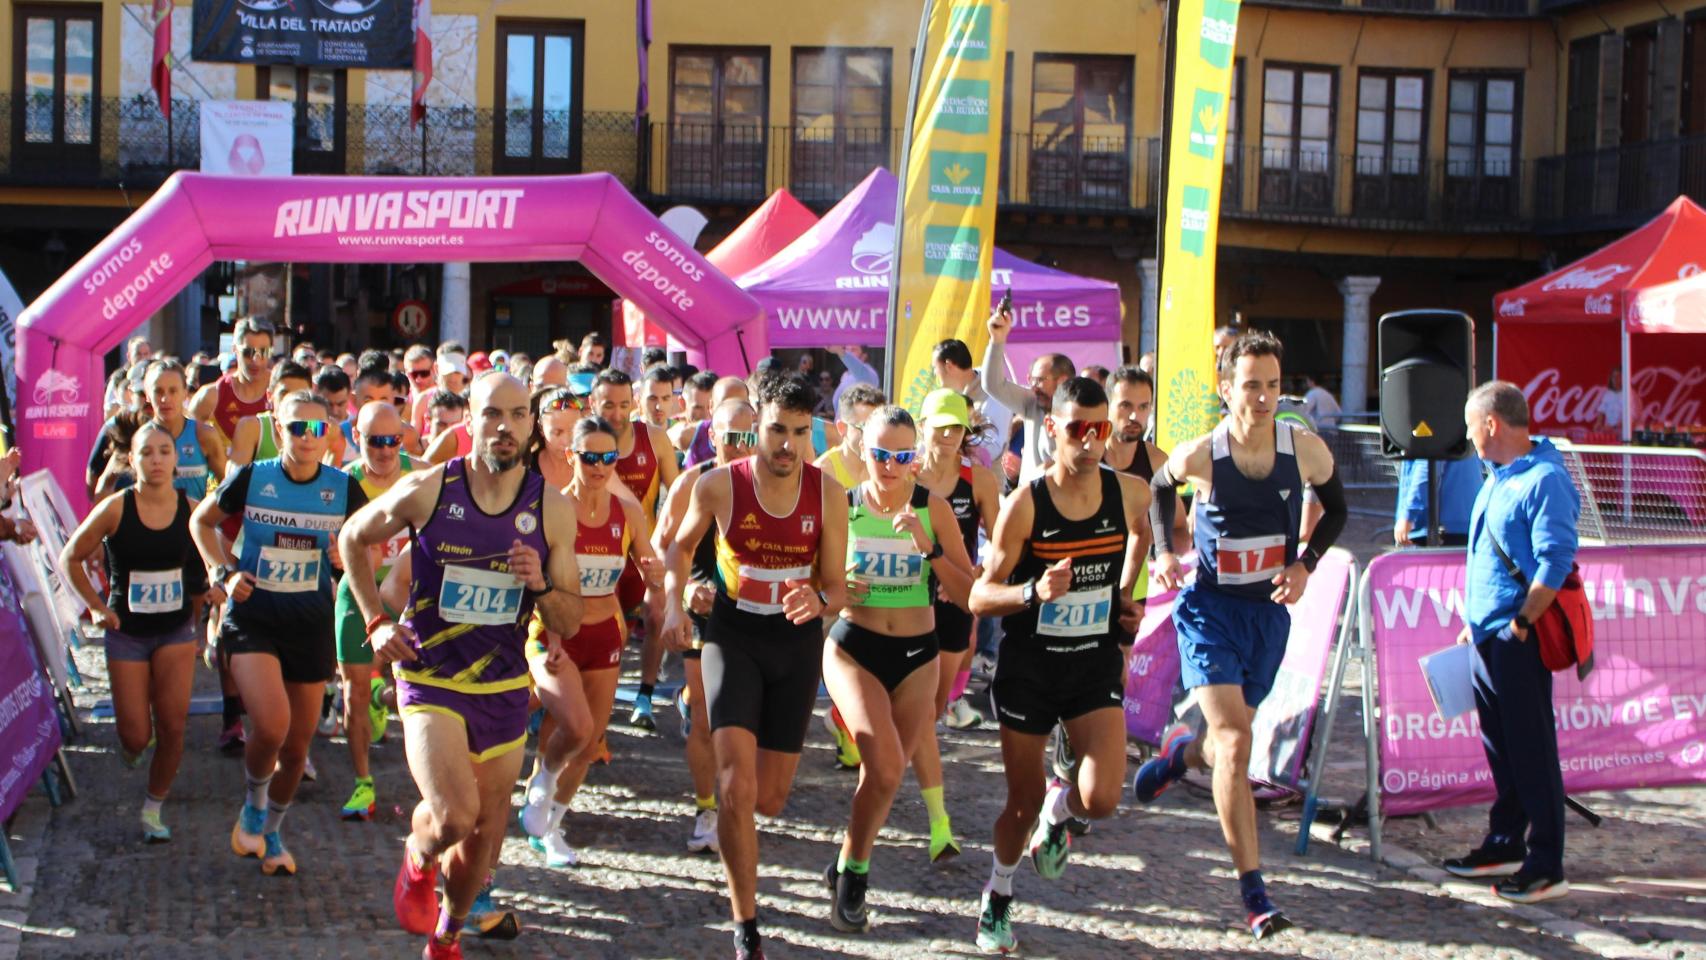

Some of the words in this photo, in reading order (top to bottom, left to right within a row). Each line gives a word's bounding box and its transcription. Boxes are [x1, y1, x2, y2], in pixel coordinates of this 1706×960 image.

[280, 18, 306, 32] DEL
[338, 234, 464, 247] www.runvasport.es
[83, 236, 143, 295] somos
[644, 231, 705, 282] somos
[102, 252, 174, 321] deporte
[622, 250, 694, 312] deporte
[248, 511, 298, 528] LAGUNA
[437, 542, 473, 556] Jamón
[584, 545, 608, 553] VINO
[1238, 549, 1265, 573] 17
[268, 560, 308, 583] 221
[864, 552, 909, 578] 215
[1073, 562, 1111, 576] VICKY
[1076, 573, 1106, 583] FOODS
[140, 582, 174, 604] 218
[454, 584, 507, 613] 204
[1053, 603, 1097, 627] 201
[1622, 698, 1663, 725] DE
[1407, 768, 1469, 790] Página
[1559, 750, 1666, 773] scripciones
